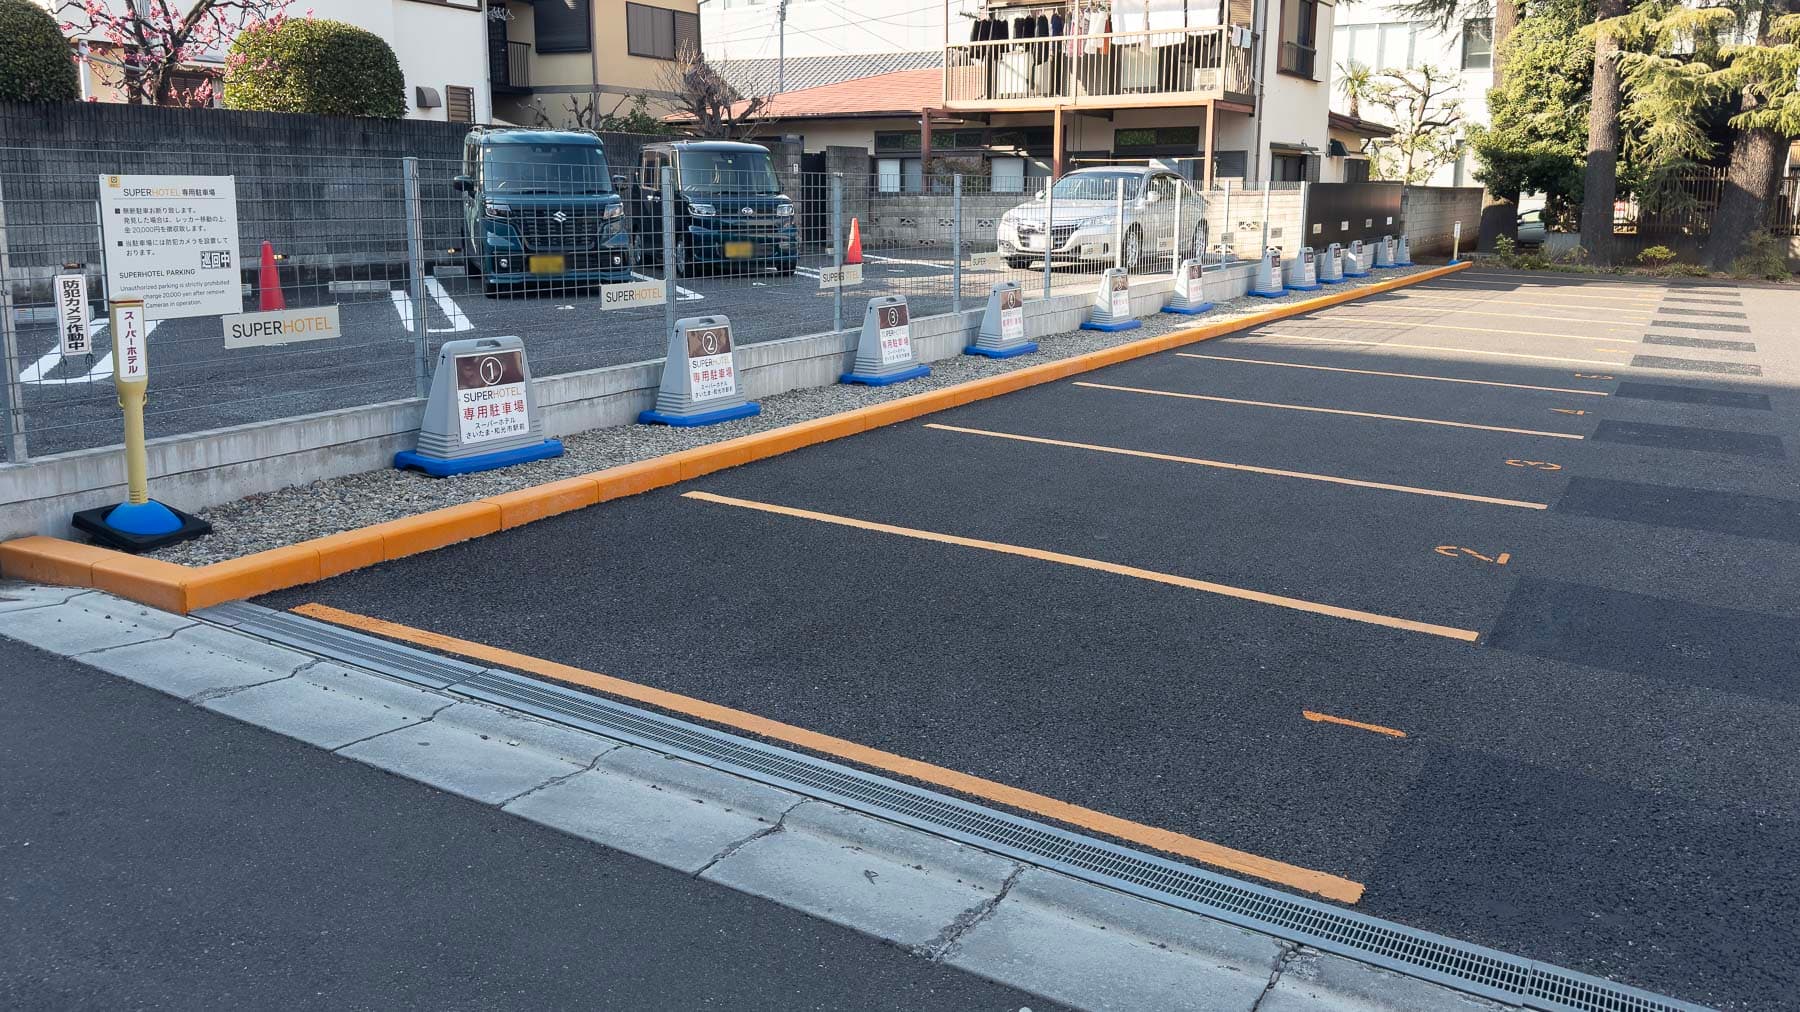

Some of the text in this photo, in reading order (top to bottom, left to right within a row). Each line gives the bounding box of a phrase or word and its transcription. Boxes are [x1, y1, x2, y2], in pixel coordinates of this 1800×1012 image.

[182, 188, 216, 196] 専用駐車場
[201, 251, 231, 269] 巡回中
[119, 268, 196, 279] SUPERHOTEL PARKING
[120, 282, 157, 292] Unauthorized
[158, 281, 178, 291] parking
[606, 287, 662, 303] SUPERHOTEL
[145, 302, 169, 310] Cameras
[63, 280, 85, 351] 防犯カメラ作動中
[232, 316, 333, 339] SUPERHOTEL
[124, 311, 138, 374] スーパーホテル
[693, 367, 733, 383] 専用駐車場
[463, 387, 521, 403] SUPERHOTEL
[463, 399, 525, 420] 専用駐車場
[475, 417, 515, 429] スーパーホテル
[1434, 545, 1511, 565] 2
